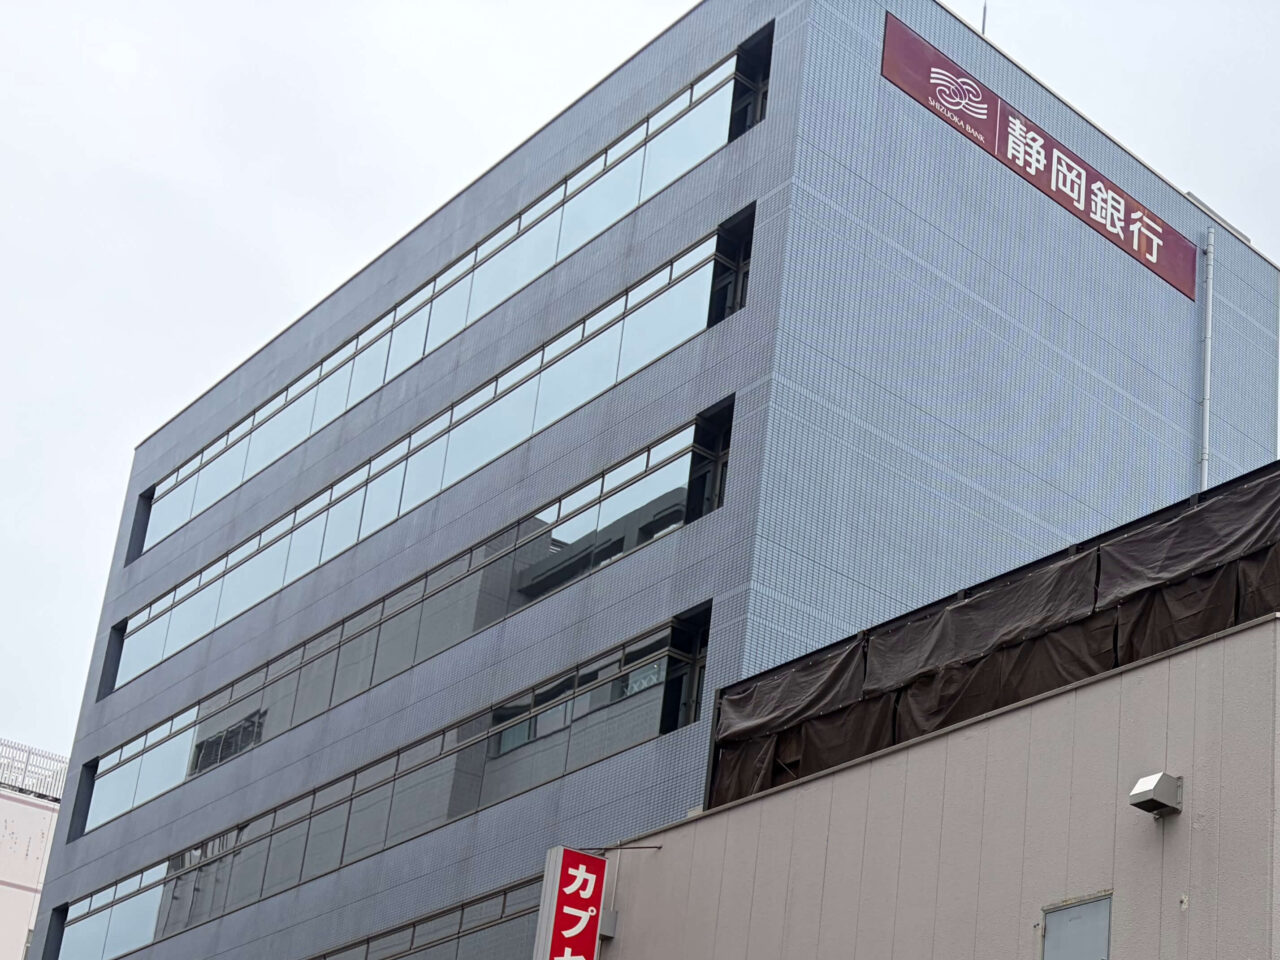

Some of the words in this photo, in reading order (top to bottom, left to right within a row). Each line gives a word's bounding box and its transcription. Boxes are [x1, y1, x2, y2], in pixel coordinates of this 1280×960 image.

[928, 96, 965, 129] SHIZUOKA
[965, 123, 985, 143] BANK
[1007, 114, 1164, 264] 静岡銀行
